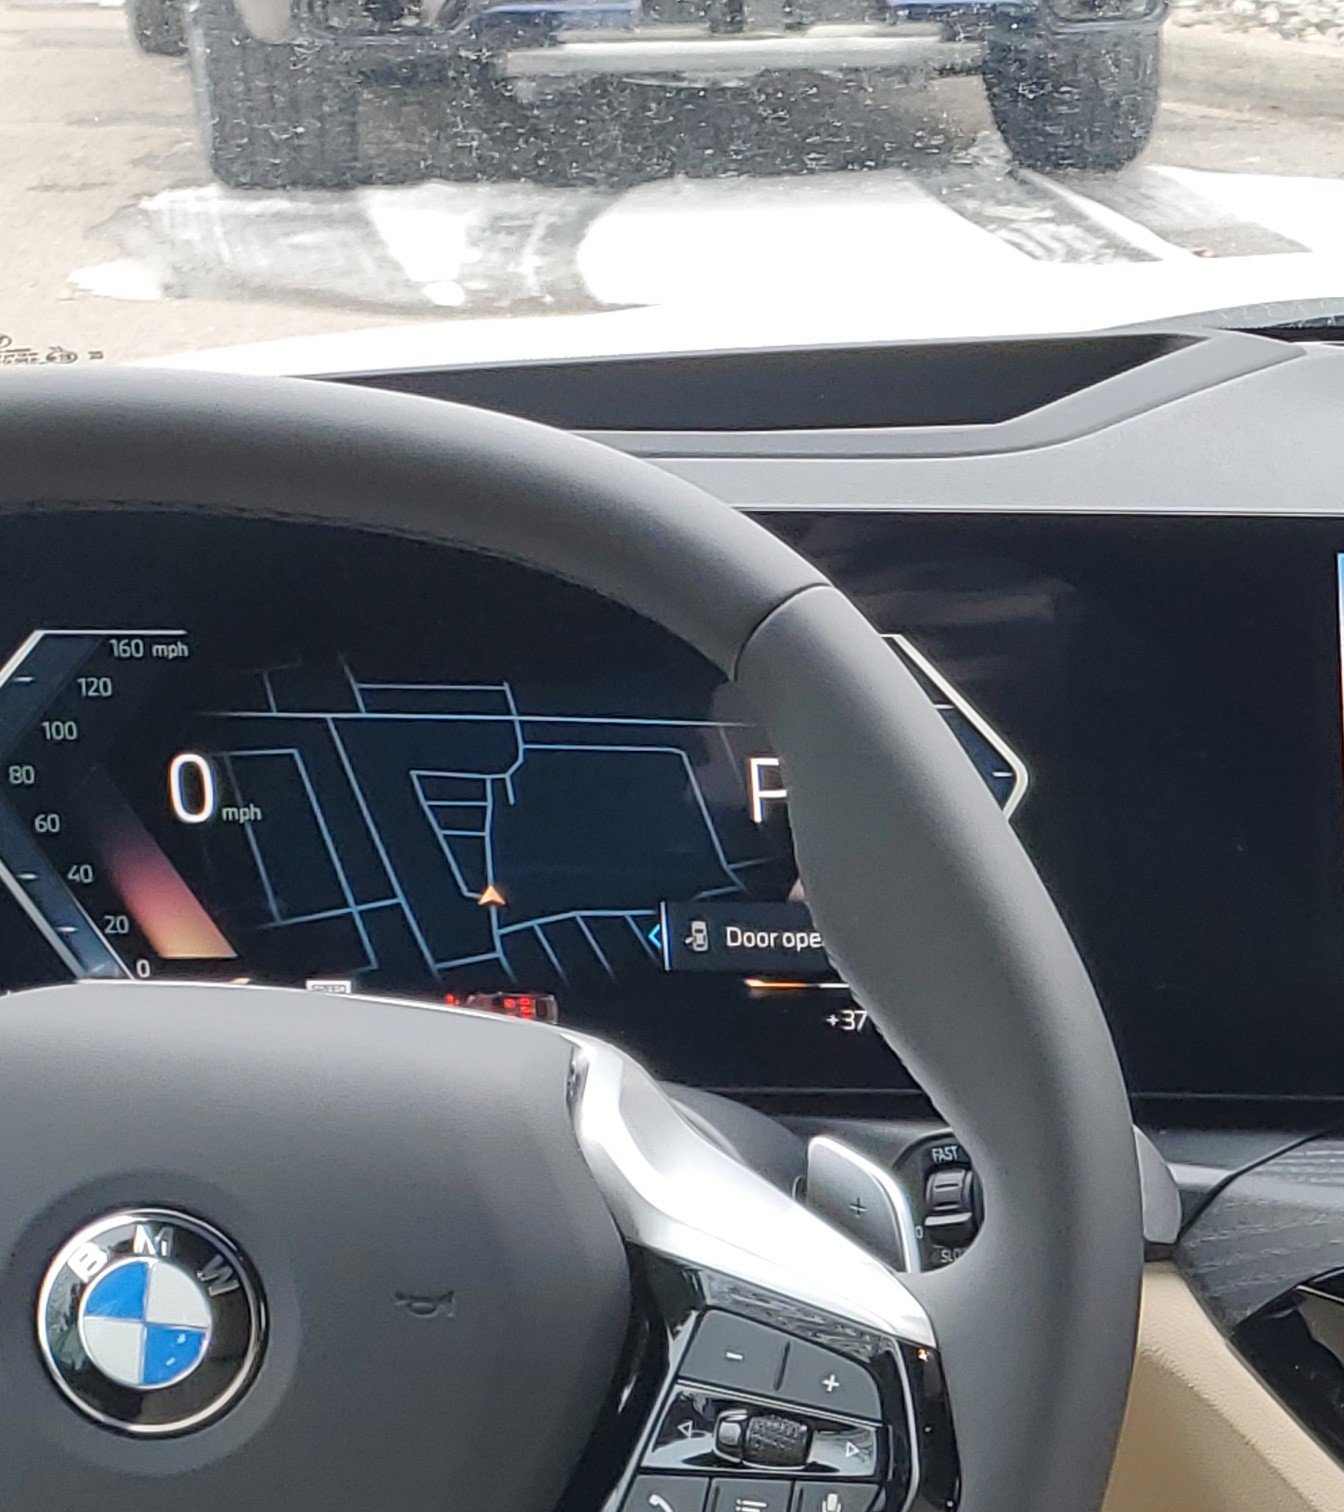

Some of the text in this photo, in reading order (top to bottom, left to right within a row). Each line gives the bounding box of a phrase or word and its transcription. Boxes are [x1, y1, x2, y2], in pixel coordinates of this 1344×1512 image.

[109, 639, 189, 661] 160 mph
[77, 677, 112, 698] 120
[42, 722, 77, 741] 100
[8, 765, 36, 785] 80
[167, 752, 262, 825] 0 mph
[34, 814, 61, 834] 60
[67, 865, 95, 884] 40
[104, 915, 129, 935] 20
[726, 926, 825, 952] Door ope
[135, 959, 151, 979] 0
[931, 1145, 960, 1162] FAST
[67, 1224, 240, 1297] BMW
[941, 1249, 964, 1263] SLO
